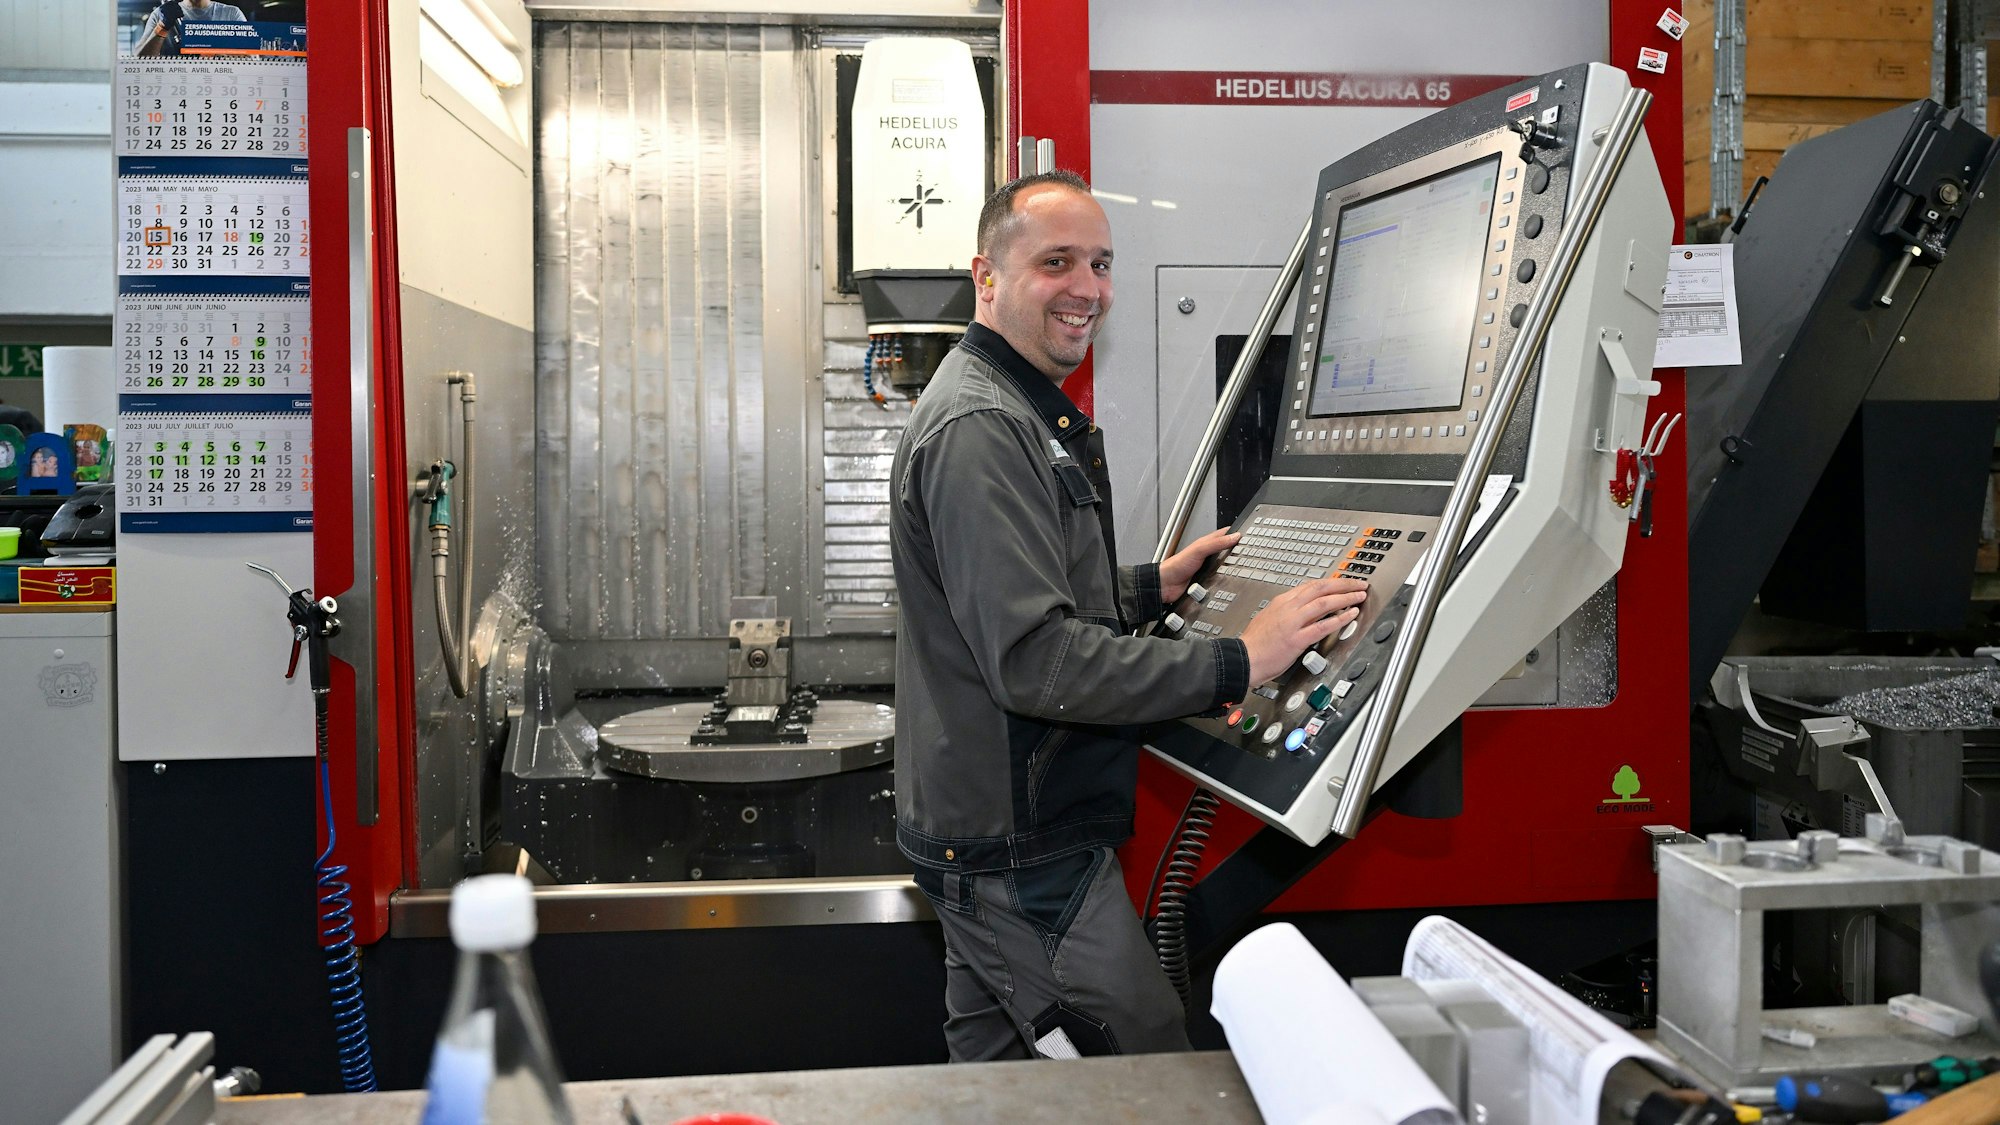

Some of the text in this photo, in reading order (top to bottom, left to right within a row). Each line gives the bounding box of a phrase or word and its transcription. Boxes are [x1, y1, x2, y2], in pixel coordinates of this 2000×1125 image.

[126, 86, 287, 97] 13 1
[1216, 79, 1450, 100] HEDELIUS ACURA 65
[126, 99, 289, 111] 14 3 4 5 6 7 8
[126, 112, 288, 124] 15 10 11 12 13 14 15
[880, 117, 958, 129] HEDELIUS
[126, 126, 288, 137] 16 17 18 19 20 21 22
[146, 140, 289, 151] 24 25 26 27 28 29
[891, 137, 947, 149] ACURA
[128, 205, 290, 216] 18 1 2 3 4 5 6
[128, 218, 290, 229] 19 8 9 10 11 12 13
[127, 232, 290, 242] 20 15 16 17 18 19 20
[127, 245, 290, 256] 21 22 23 24 25 26 27
[126, 259, 210, 268] 22 29 30 31
[232, 323, 290, 333] 1 2 3
[156, 336, 290, 346] 5 6 7 9 10
[149, 350, 290, 360] 12 13 14 15 16 17
[149, 363, 291, 373] 19 20 21 22 23 24
[147, 377, 265, 386] 26 27 28 29 30
[157, 442, 292, 452] 3 4 5 6 7 8
[150, 455, 291, 465] 10 11 12 13 14 15
[150, 468, 292, 479] 17 18 19 20 21 22
[148, 482, 292, 492] 24 25 26 27 28 29
[149, 496, 162, 506] 31
[1596, 804, 1655, 814] ECO MODE
